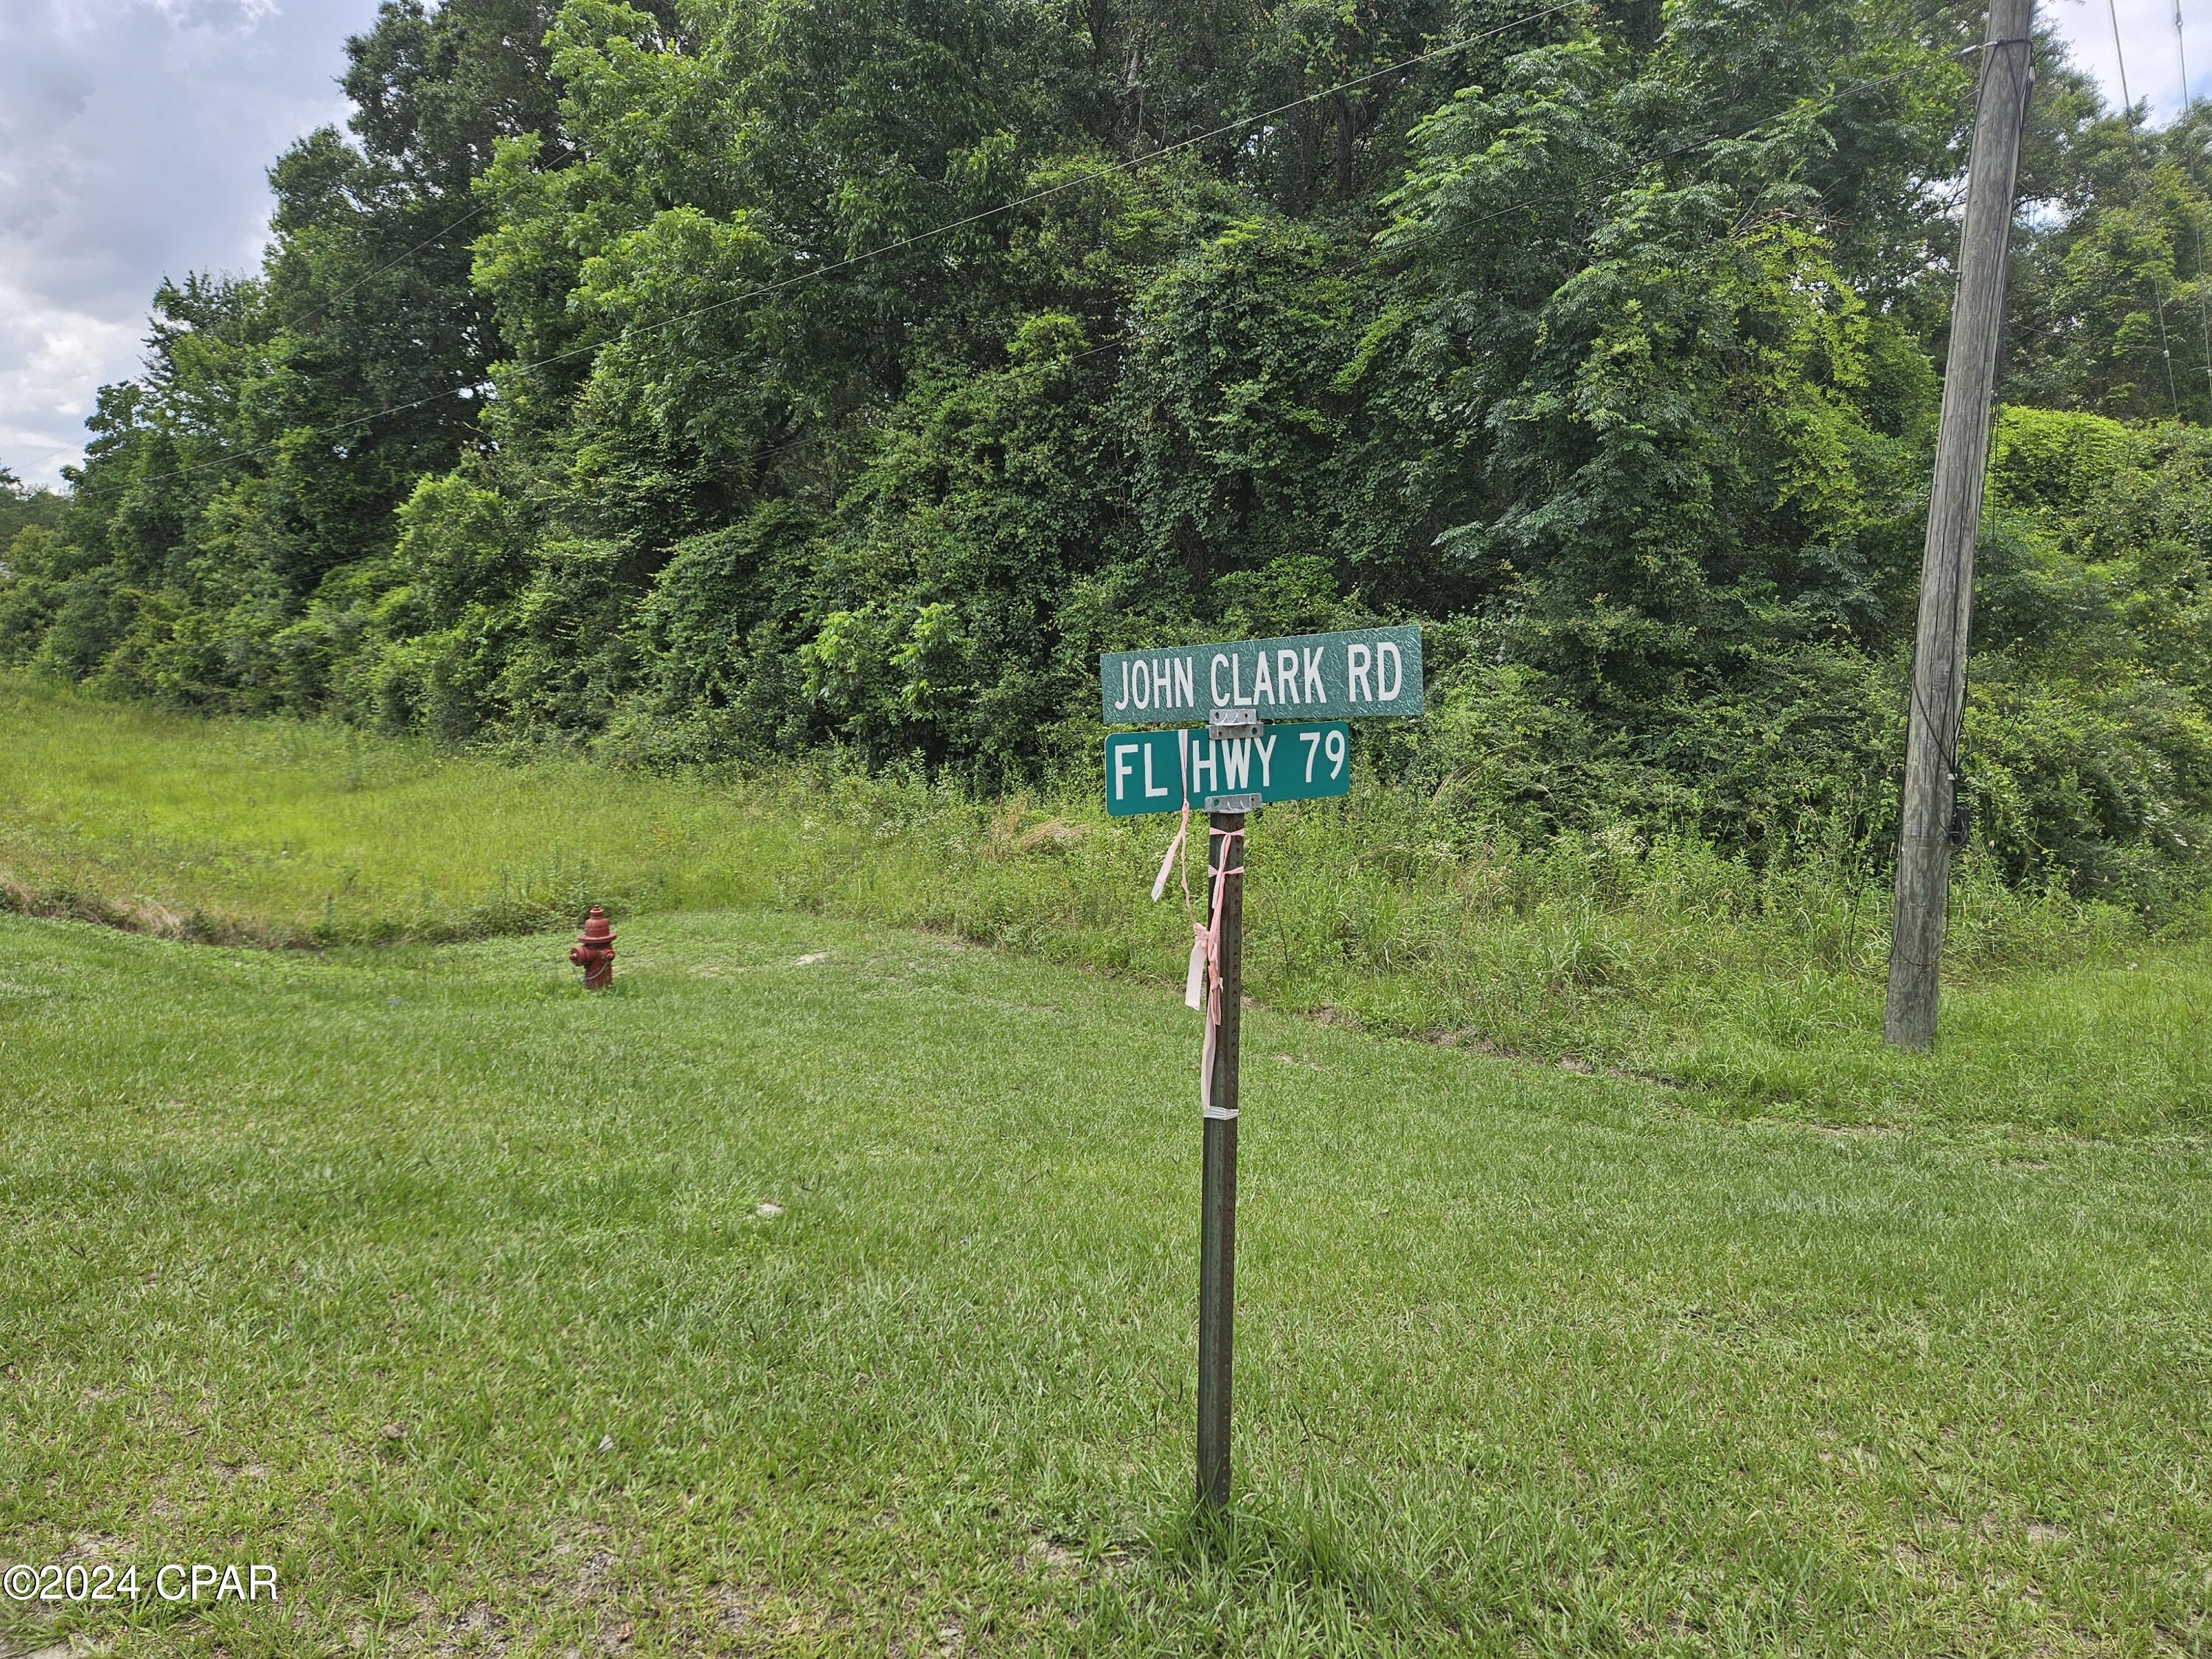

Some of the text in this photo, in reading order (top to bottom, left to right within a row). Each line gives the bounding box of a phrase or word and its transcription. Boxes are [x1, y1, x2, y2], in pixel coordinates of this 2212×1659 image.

[1114, 641, 1403, 711] JOHN CLARK RD
[1114, 729, 1346, 800] FL HWY 79
